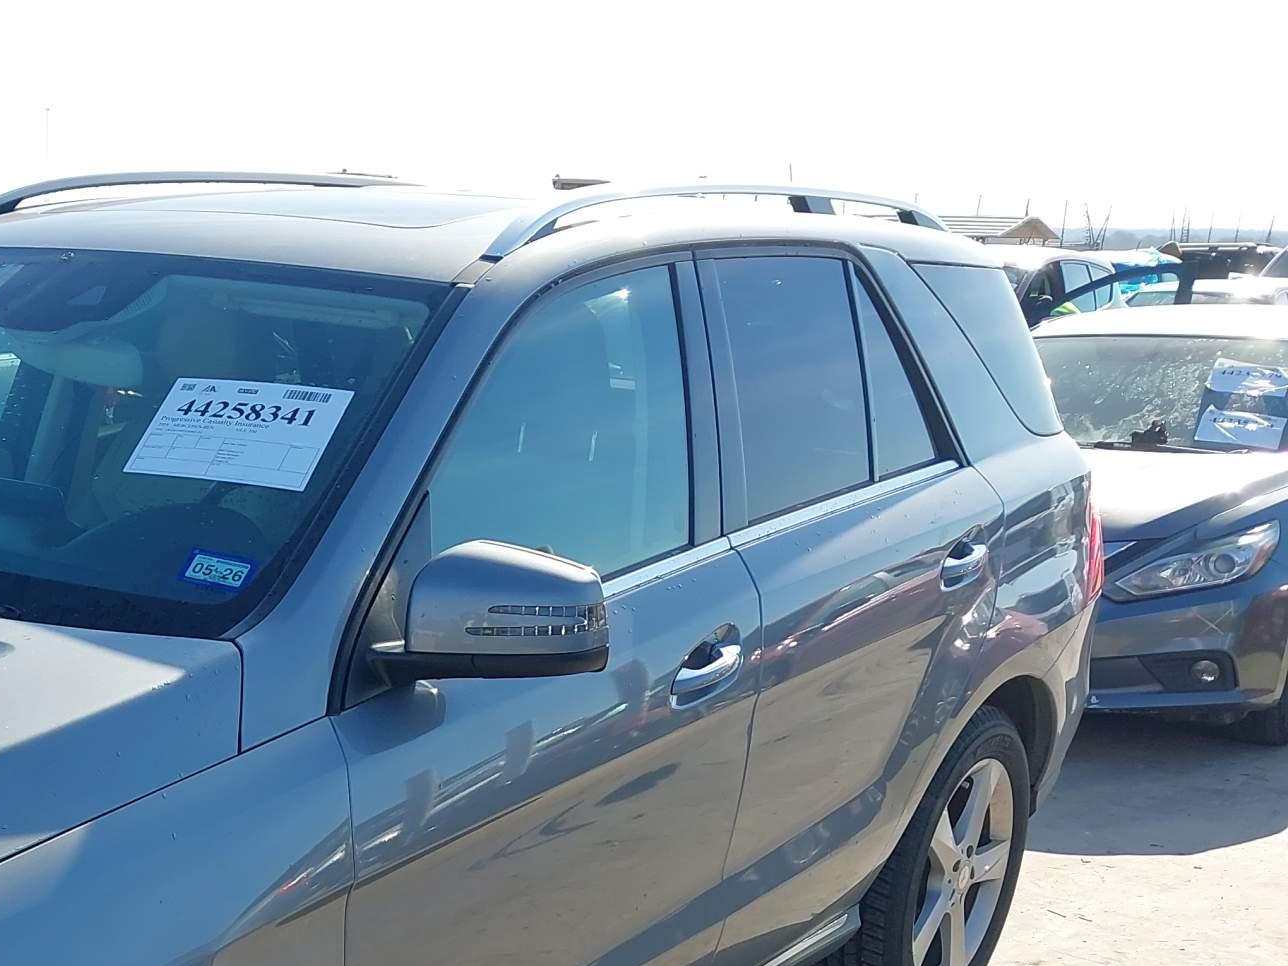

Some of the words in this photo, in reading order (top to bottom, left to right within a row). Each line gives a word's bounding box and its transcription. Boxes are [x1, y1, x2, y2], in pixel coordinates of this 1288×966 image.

[161, 415, 202, 425] Progressive
[202, 418, 233, 427] Casualty
[234, 420, 270, 429] Insurance
[176, 399, 316, 427] 44258341
[192, 562, 216, 576] 05
[220, 568, 245, 582] 26
